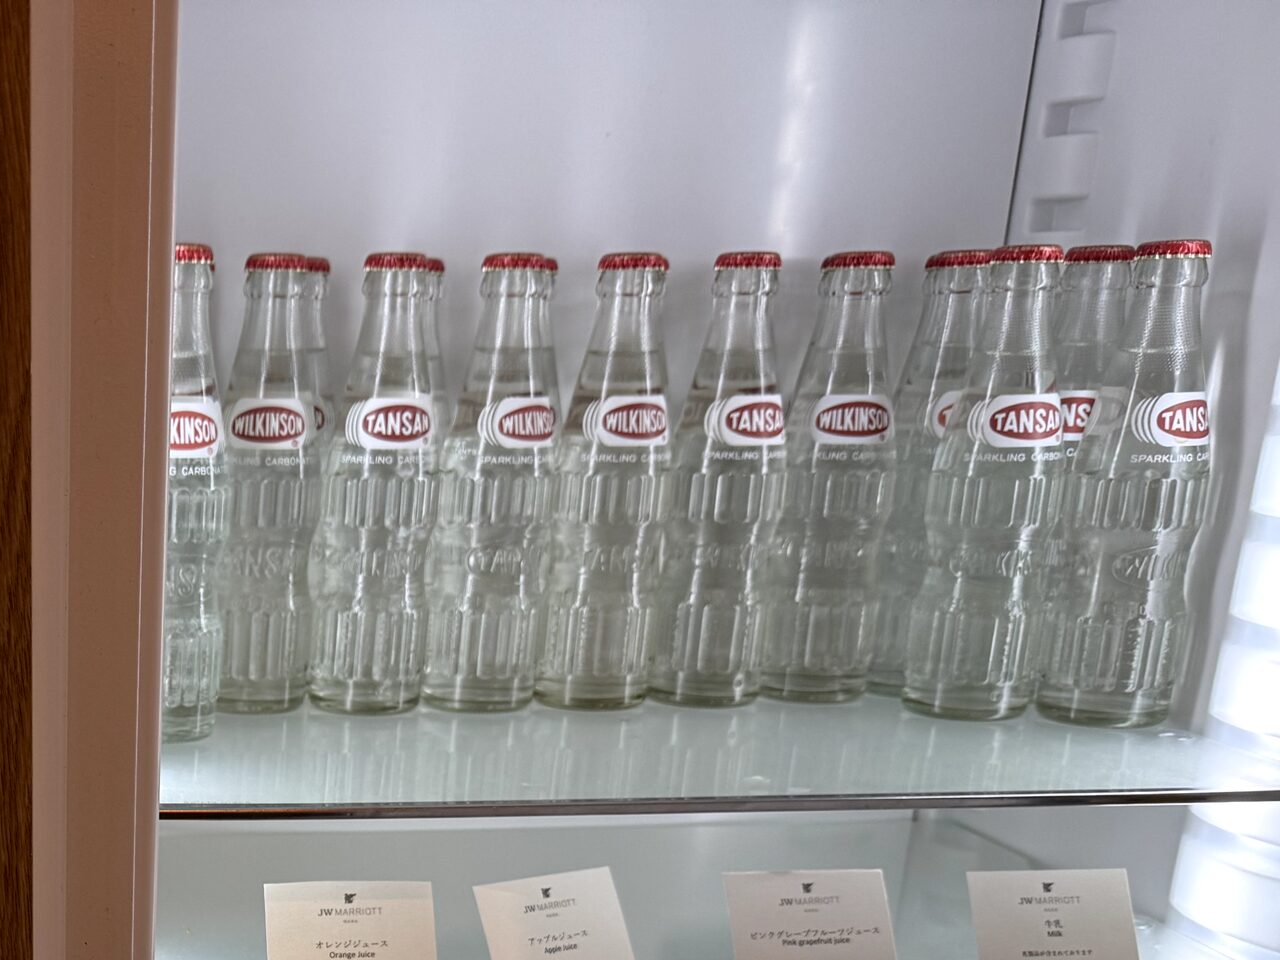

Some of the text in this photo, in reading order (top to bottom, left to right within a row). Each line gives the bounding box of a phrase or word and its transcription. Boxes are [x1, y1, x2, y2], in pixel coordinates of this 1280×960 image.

[366, 411, 429, 436] TANSAN
[606, 408, 666, 434] WILKINSO
[729, 409, 784, 432] TANSA
[819, 407, 889, 432] WILKINSON
[1161, 406, 1209, 432] TANS
[170, 416, 216, 444] KINSON
[233, 412, 303, 438] WILKINSON
[1130, 453, 1193, 463] SPARKLING
[779, 896, 840, 906] JW MARRIOTT
[1018, 896, 1080, 905] JW MARRIOTT
[523, 898, 576, 914] JW MARRIOTT
[318, 907, 382, 917] JW MARRIOTT
[1047, 930, 1063, 938] Milk
[316, 940, 389, 949] オレンジジュース
[782, 937, 851, 947] Pink grapefruit juice
[544, 945, 562, 954] Apple
[329, 951, 356, 959] Orange
